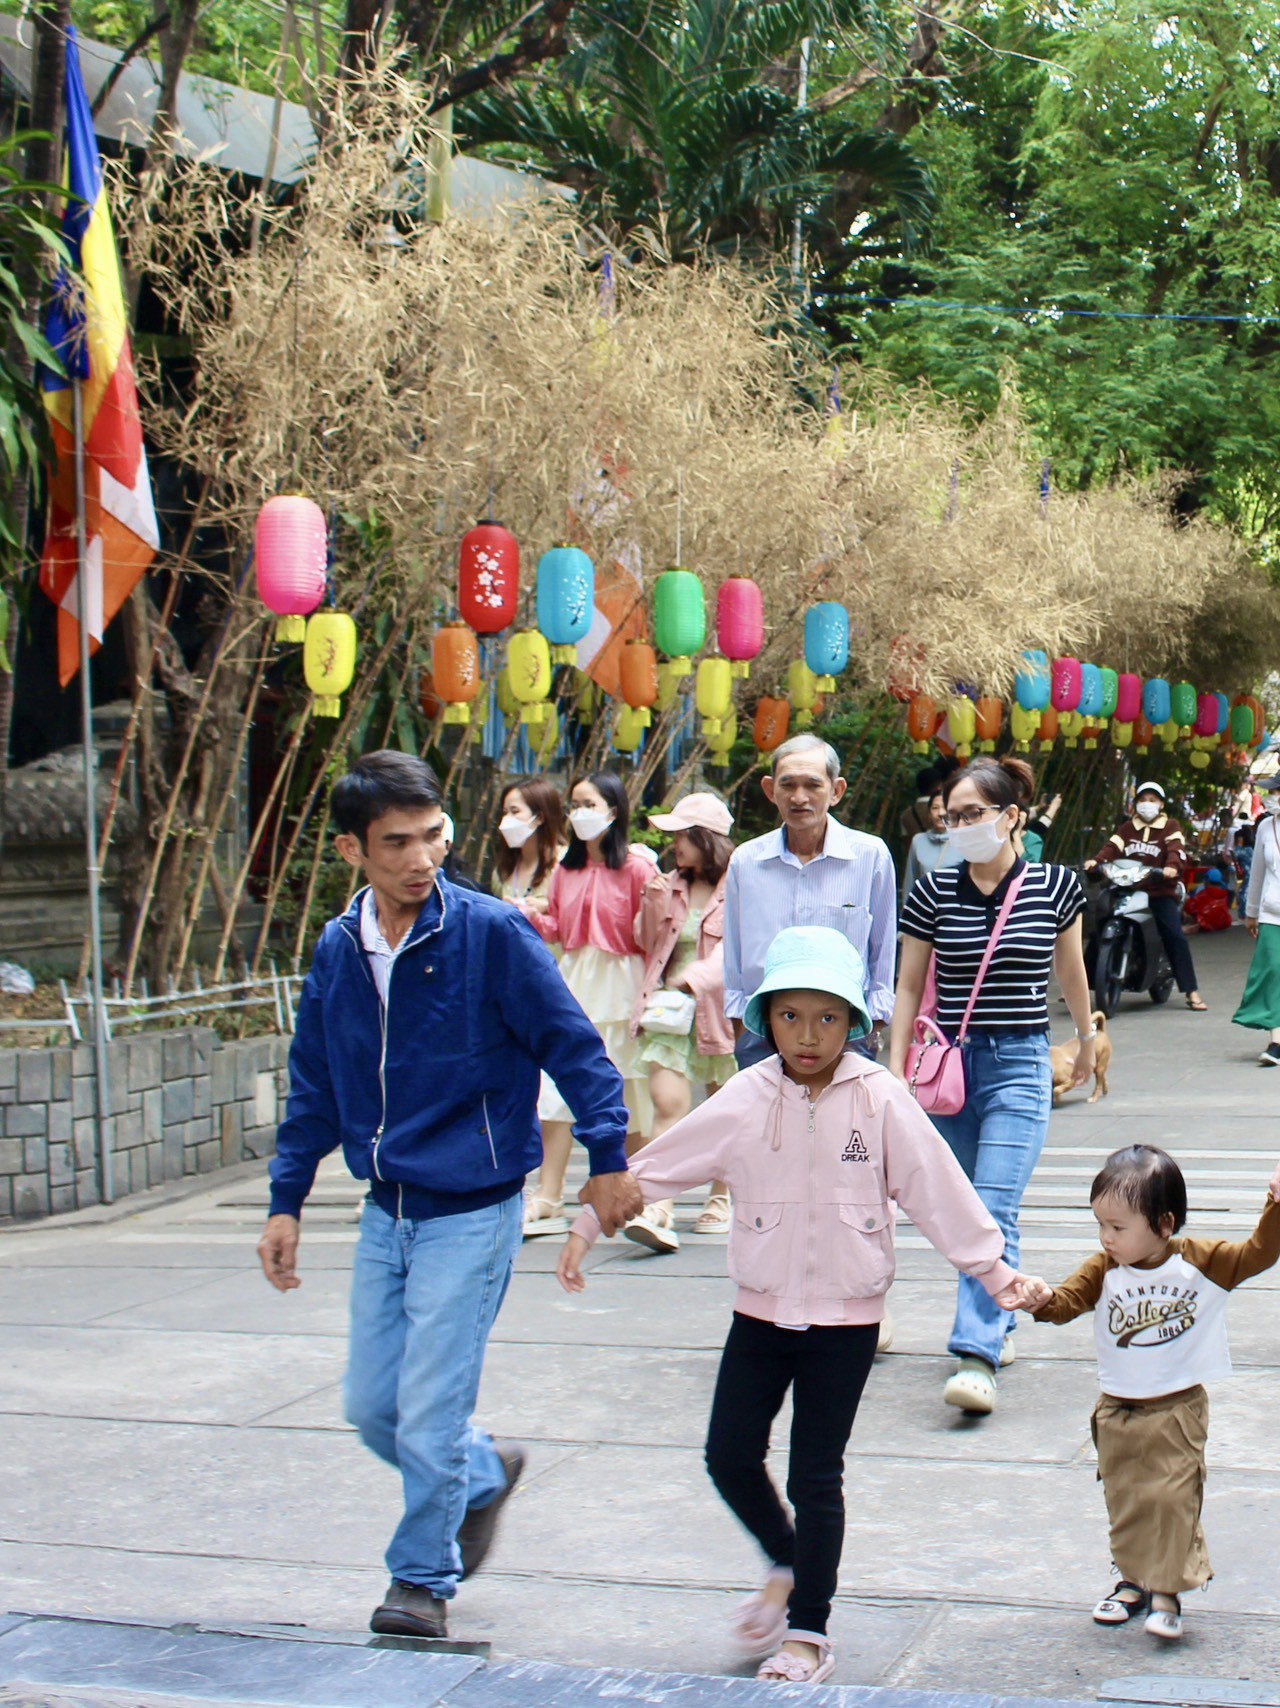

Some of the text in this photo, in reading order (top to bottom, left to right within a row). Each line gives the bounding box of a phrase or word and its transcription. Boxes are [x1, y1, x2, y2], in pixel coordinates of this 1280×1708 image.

[845, 1129, 867, 1153] A
[841, 1154, 870, 1163] DREAK
[1108, 1300, 1197, 1335] College
